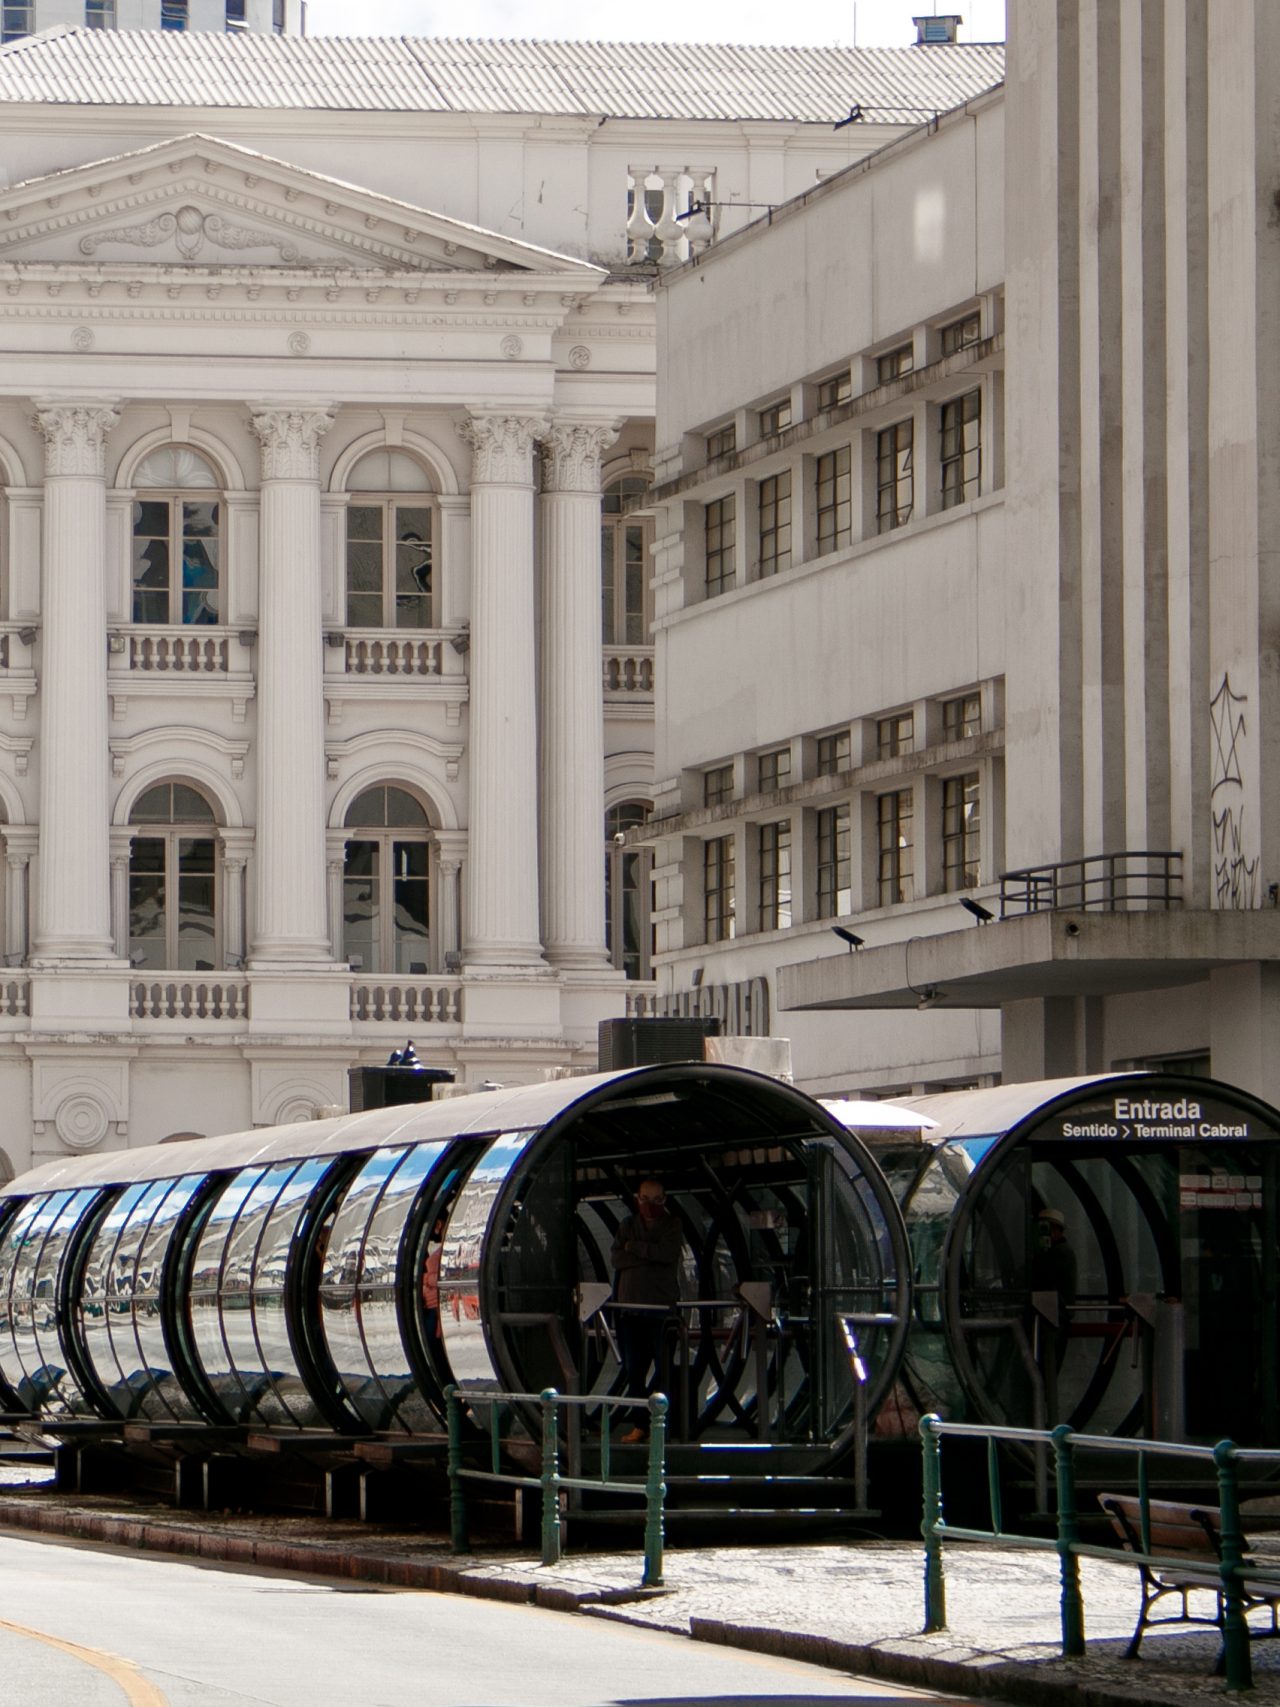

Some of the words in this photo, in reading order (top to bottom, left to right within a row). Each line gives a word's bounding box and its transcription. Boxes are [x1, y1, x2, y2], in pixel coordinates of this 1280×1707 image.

[1114, 1098, 1201, 1120] Entrada
[1062, 1122, 1118, 1137] Sentido
[1134, 1123, 1195, 1137] Terminal
[1199, 1123, 1247, 1137] Cabral
